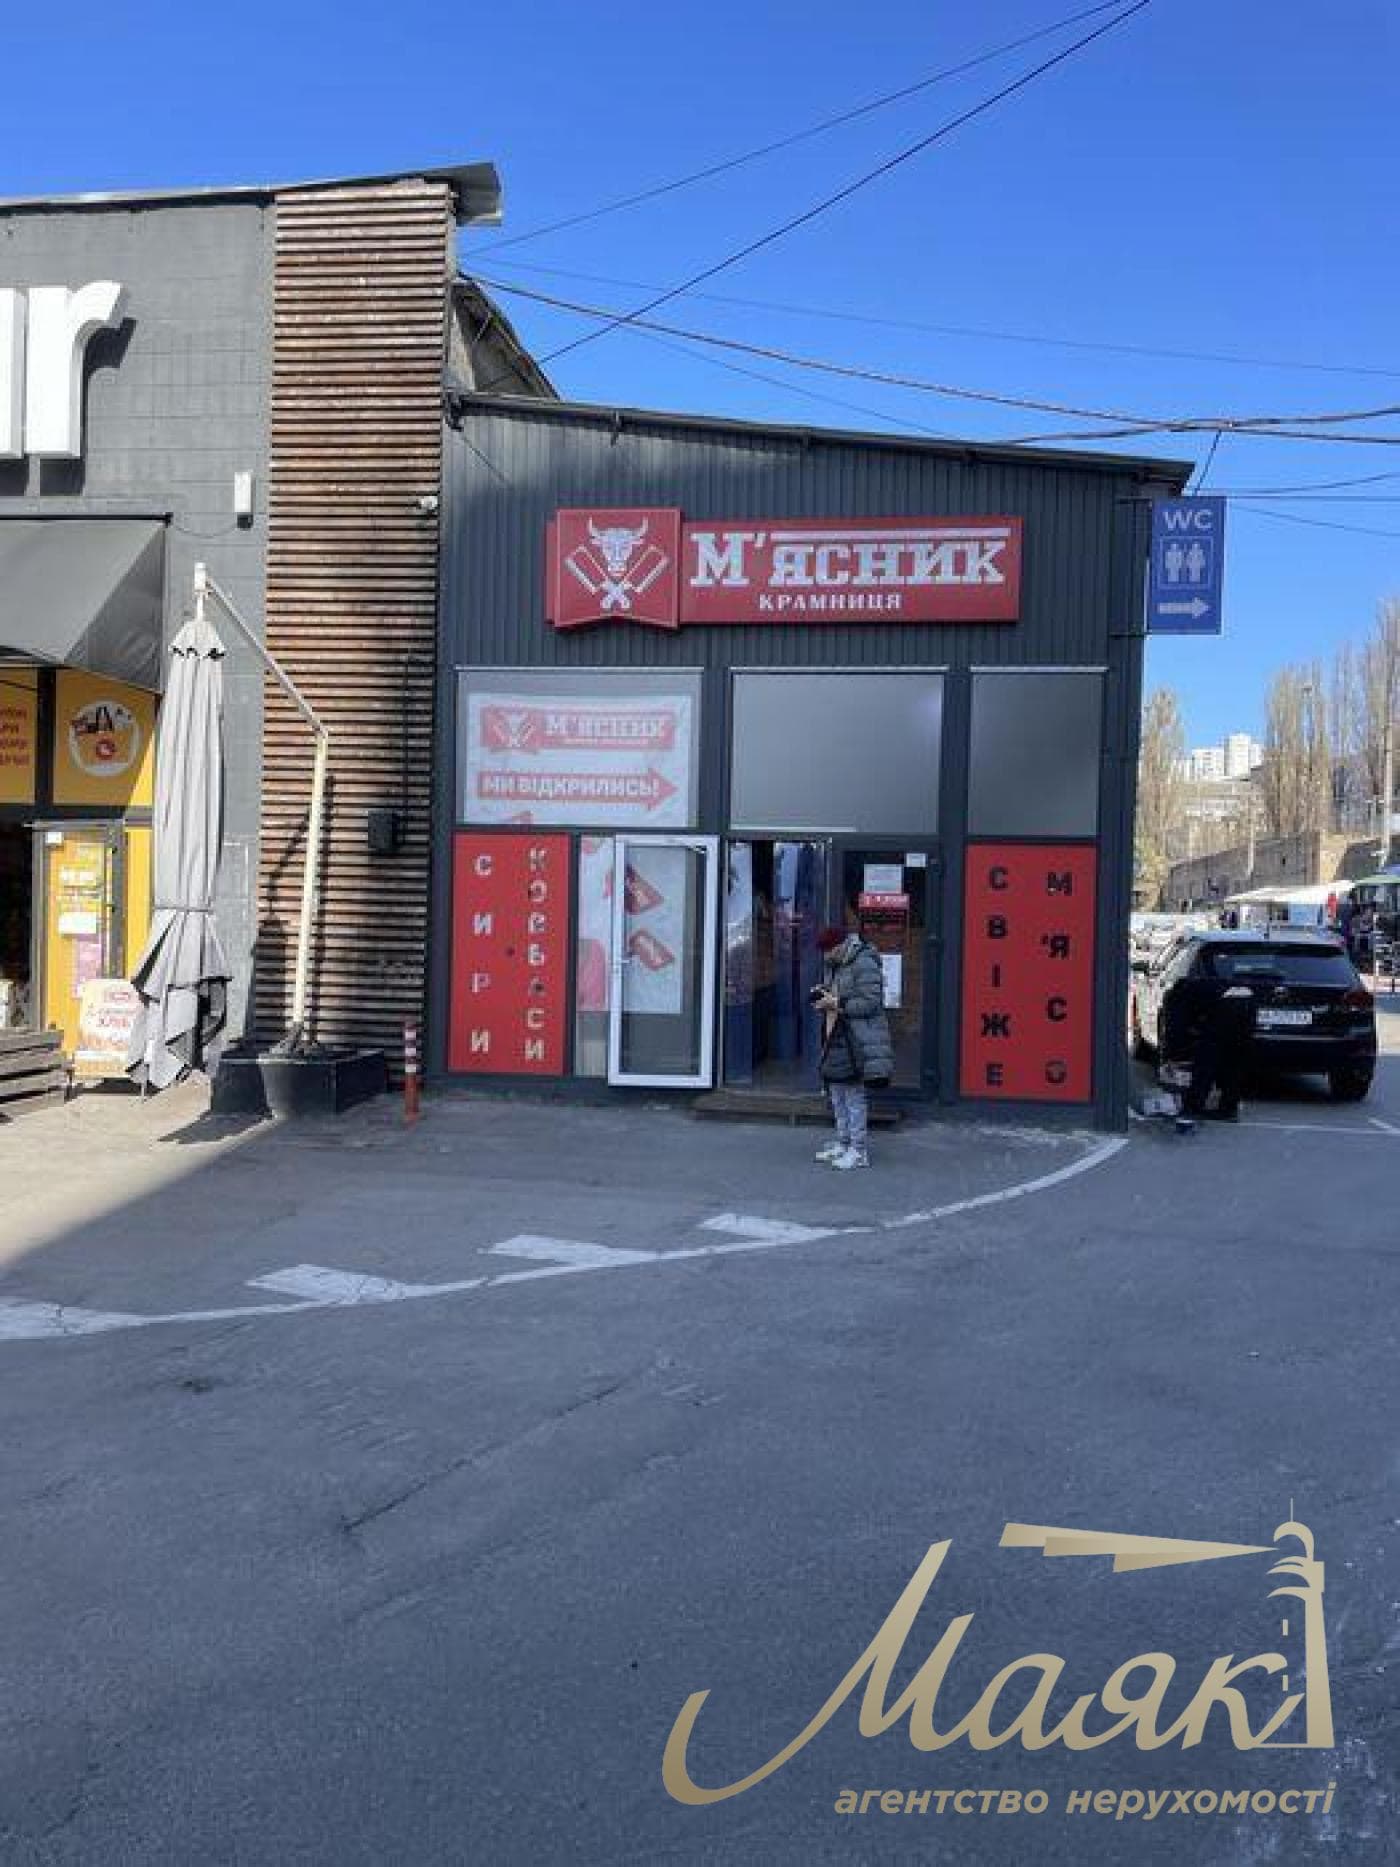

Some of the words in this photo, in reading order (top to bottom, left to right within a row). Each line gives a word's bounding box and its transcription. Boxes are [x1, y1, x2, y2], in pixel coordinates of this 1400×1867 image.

[1163, 509, 1213, 531] WC
[689, 530, 1006, 588] М'ЯСНИК
[758, 593, 903, 611] КРАМНИЦЯ
[980, 866, 1011, 1087] СВІЖЕ
